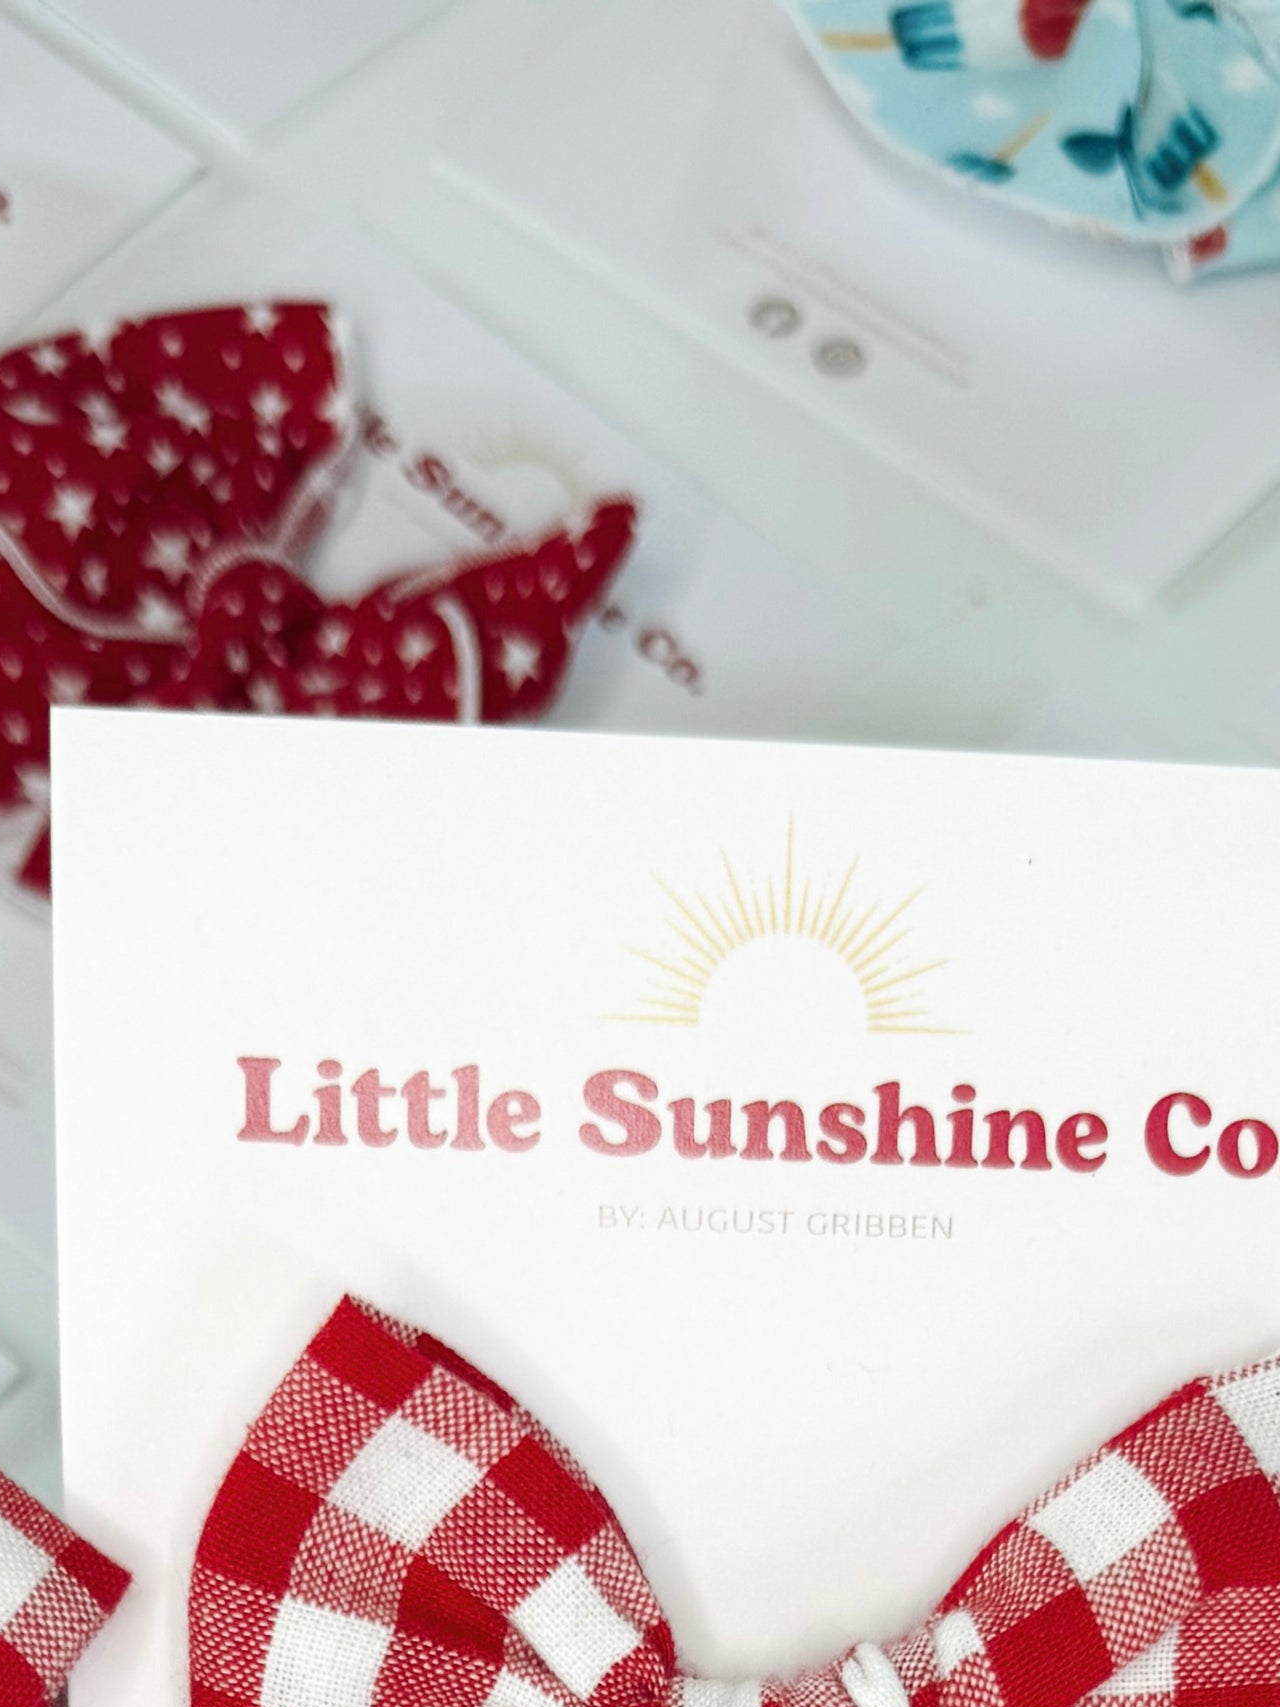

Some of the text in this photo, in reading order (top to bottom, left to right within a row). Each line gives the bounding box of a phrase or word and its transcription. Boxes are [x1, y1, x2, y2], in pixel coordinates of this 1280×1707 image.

[236, 1055, 542, 1154] Little
[578, 1069, 1110, 1176] Sunshine
[598, 1203, 955, 1240] BY: AUGUST GRIBBEN
